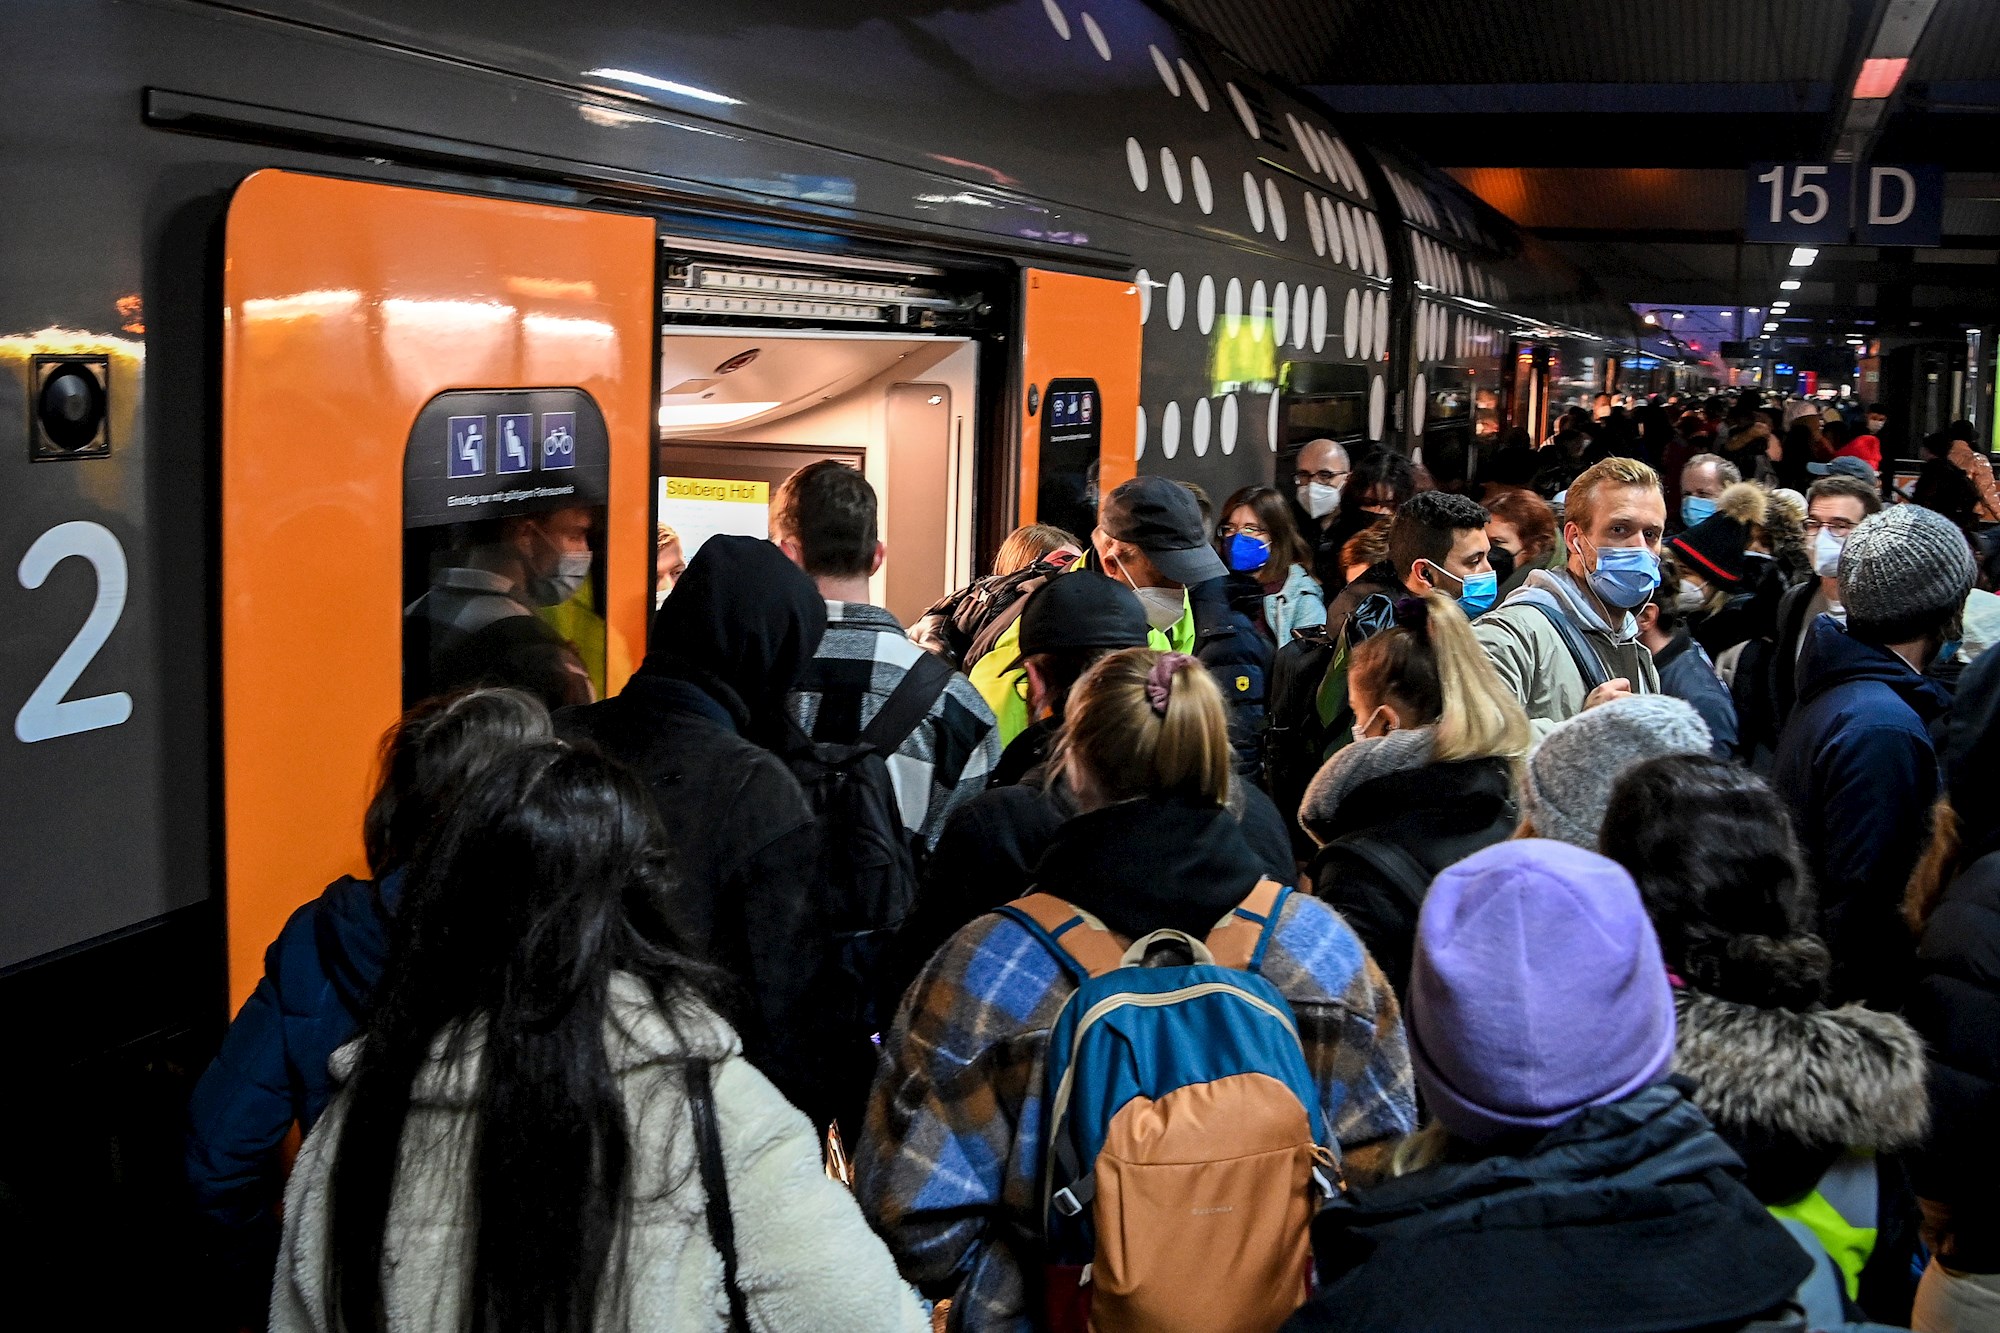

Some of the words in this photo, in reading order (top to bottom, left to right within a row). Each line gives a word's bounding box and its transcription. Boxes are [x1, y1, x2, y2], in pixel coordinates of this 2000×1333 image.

[1757, 165, 1830, 224] 15
[1868, 166, 1916, 225] D
[666, 480, 726, 501] Stolberg
[729, 484, 756, 500] Hbf
[15, 520, 134, 743] 2
